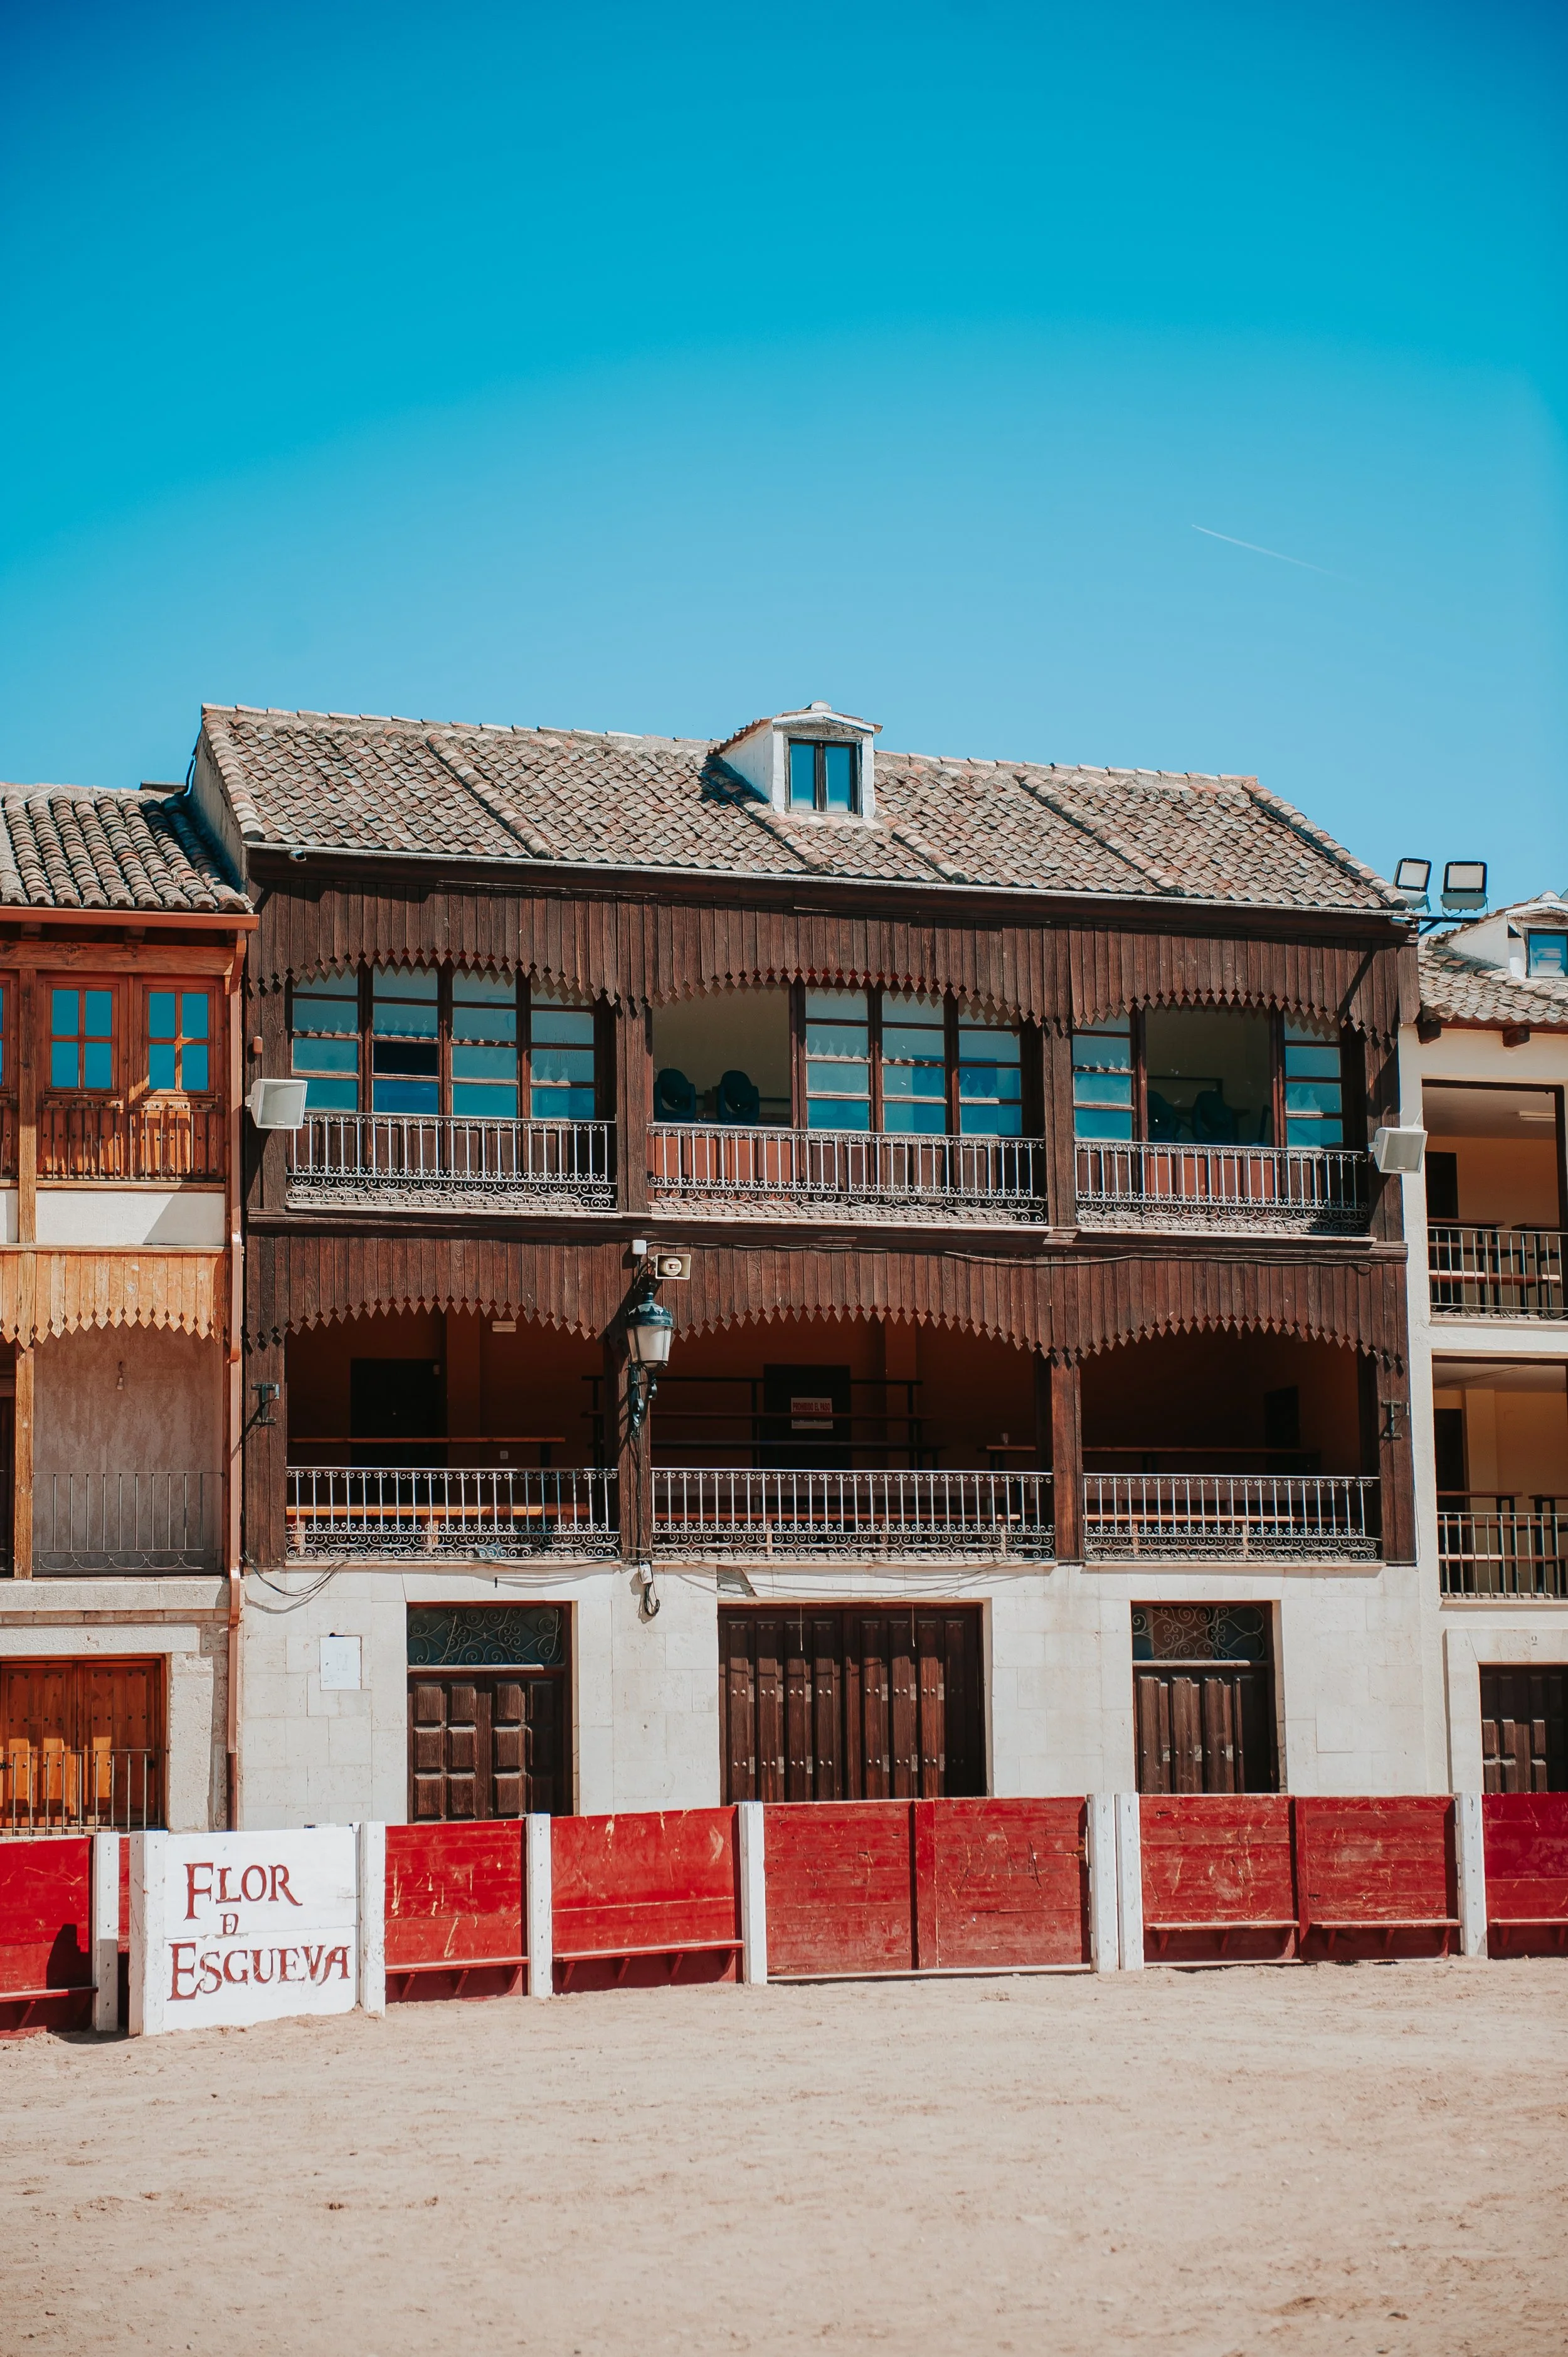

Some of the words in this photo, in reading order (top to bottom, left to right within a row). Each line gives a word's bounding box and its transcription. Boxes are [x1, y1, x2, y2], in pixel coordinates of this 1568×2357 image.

[814, 1402, 820, 1411] EL
[820, 1402, 830, 1411] PASO
[183, 1862, 303, 1921] FLOR
[167, 1942, 351, 2001] ESGUEVA
